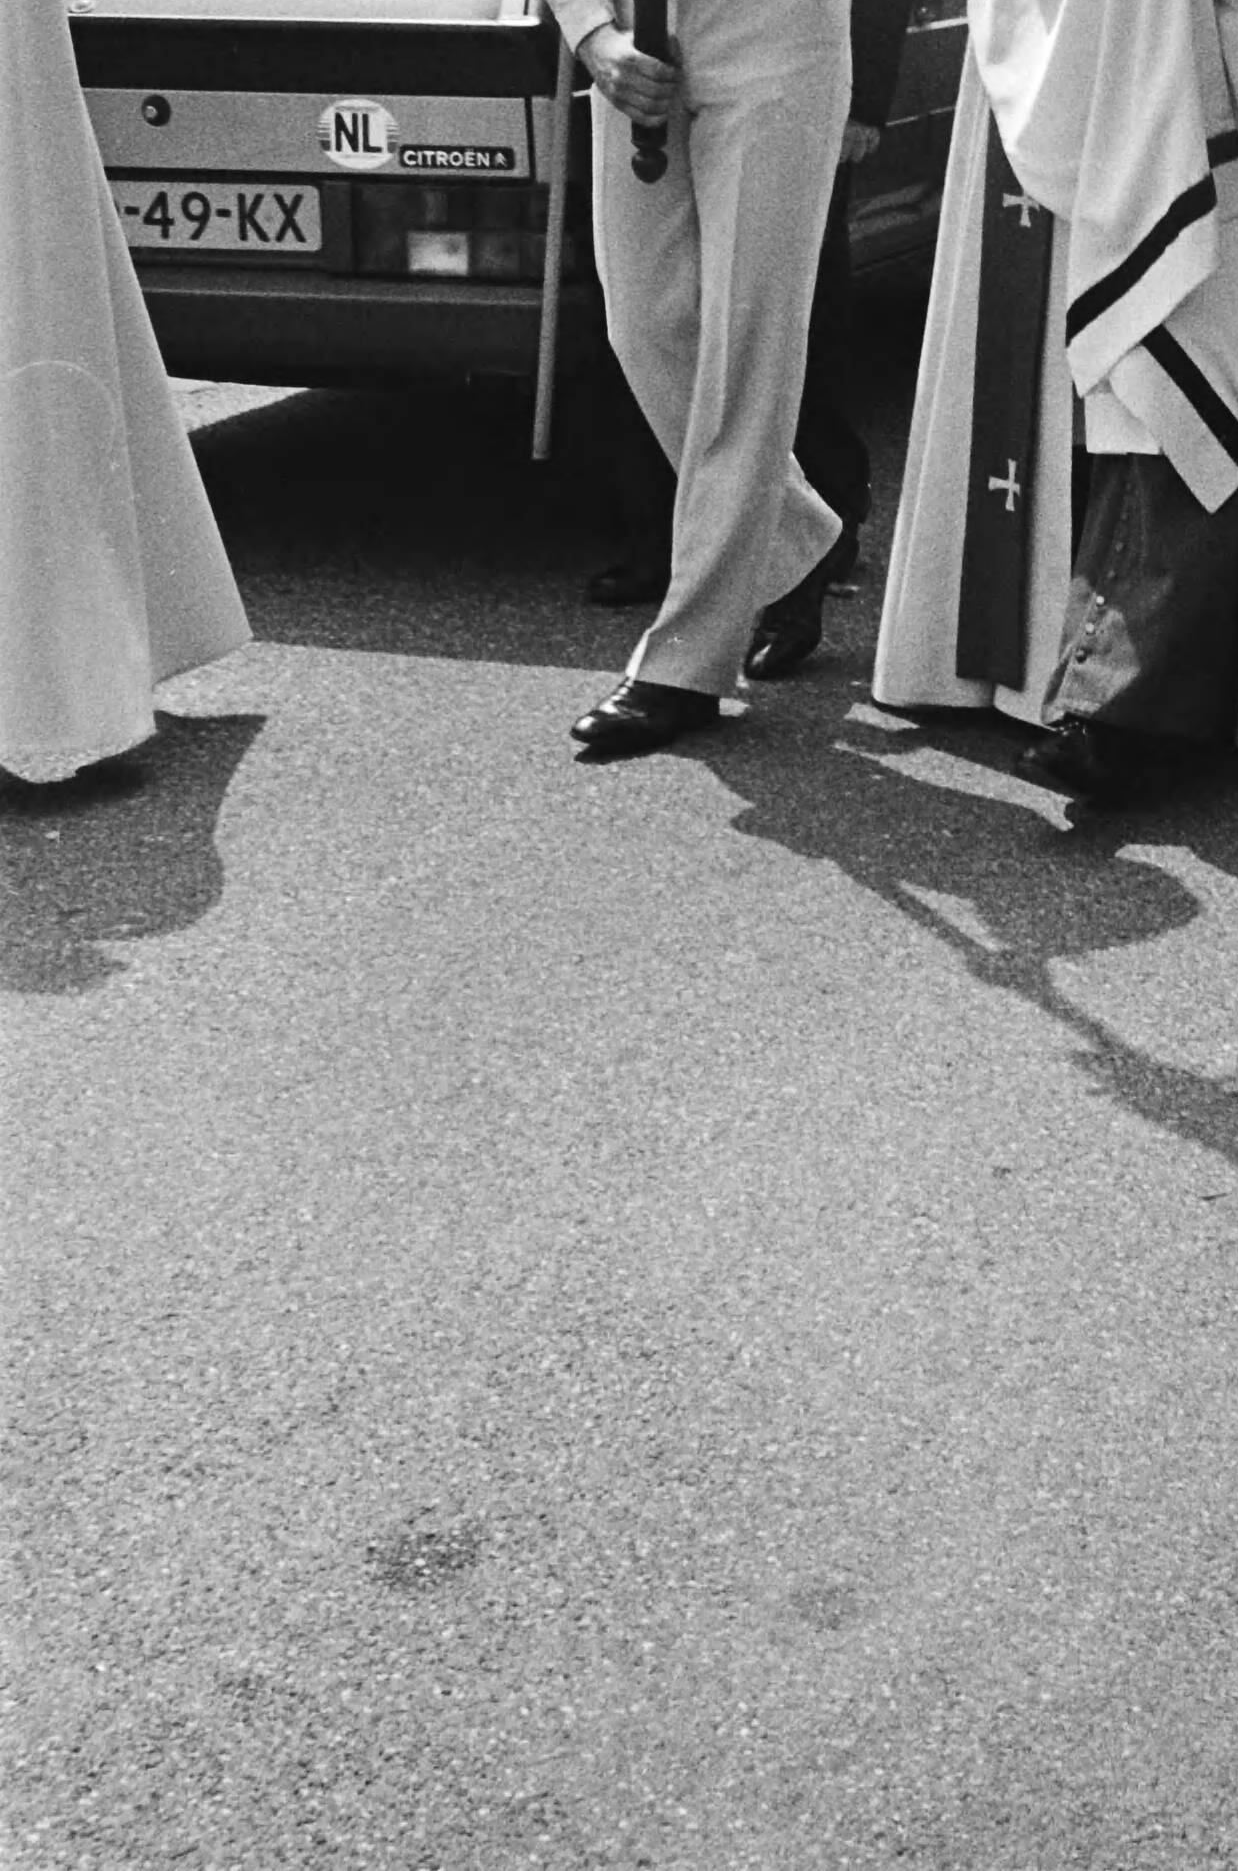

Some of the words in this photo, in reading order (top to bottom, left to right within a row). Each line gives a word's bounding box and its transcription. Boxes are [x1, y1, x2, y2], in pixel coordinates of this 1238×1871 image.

[334, 112, 383, 154] NL
[403, 147, 491, 168] CITROËN
[113, 191, 306, 243] -49-KX
